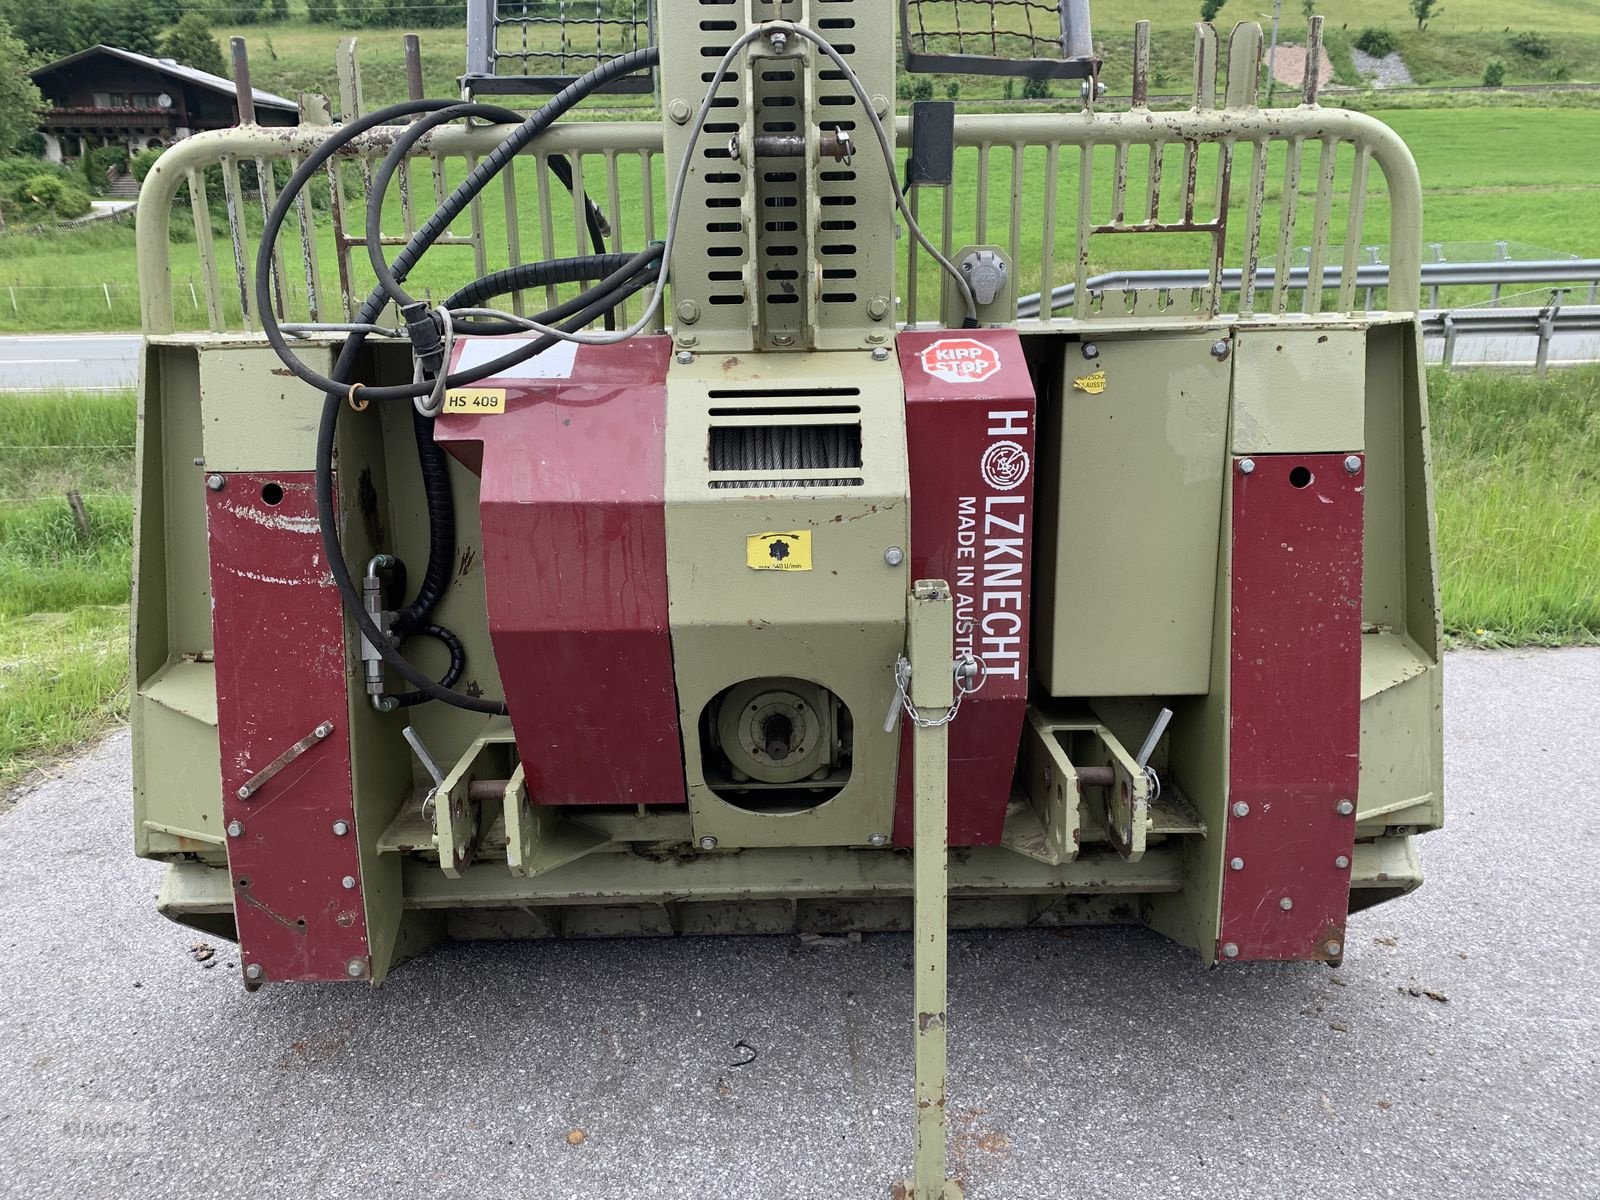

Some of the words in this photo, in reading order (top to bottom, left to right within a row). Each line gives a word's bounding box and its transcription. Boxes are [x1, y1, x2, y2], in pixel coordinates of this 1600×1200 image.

[935, 347, 983, 360] KIPP
[935, 359, 989, 374] STOP
[449, 396, 467, 407] HS
[472, 396, 498, 407] 409
[957, 496, 977, 559] MADE
[956, 566, 975, 586] IN
[955, 592, 975, 680] AUSTR
